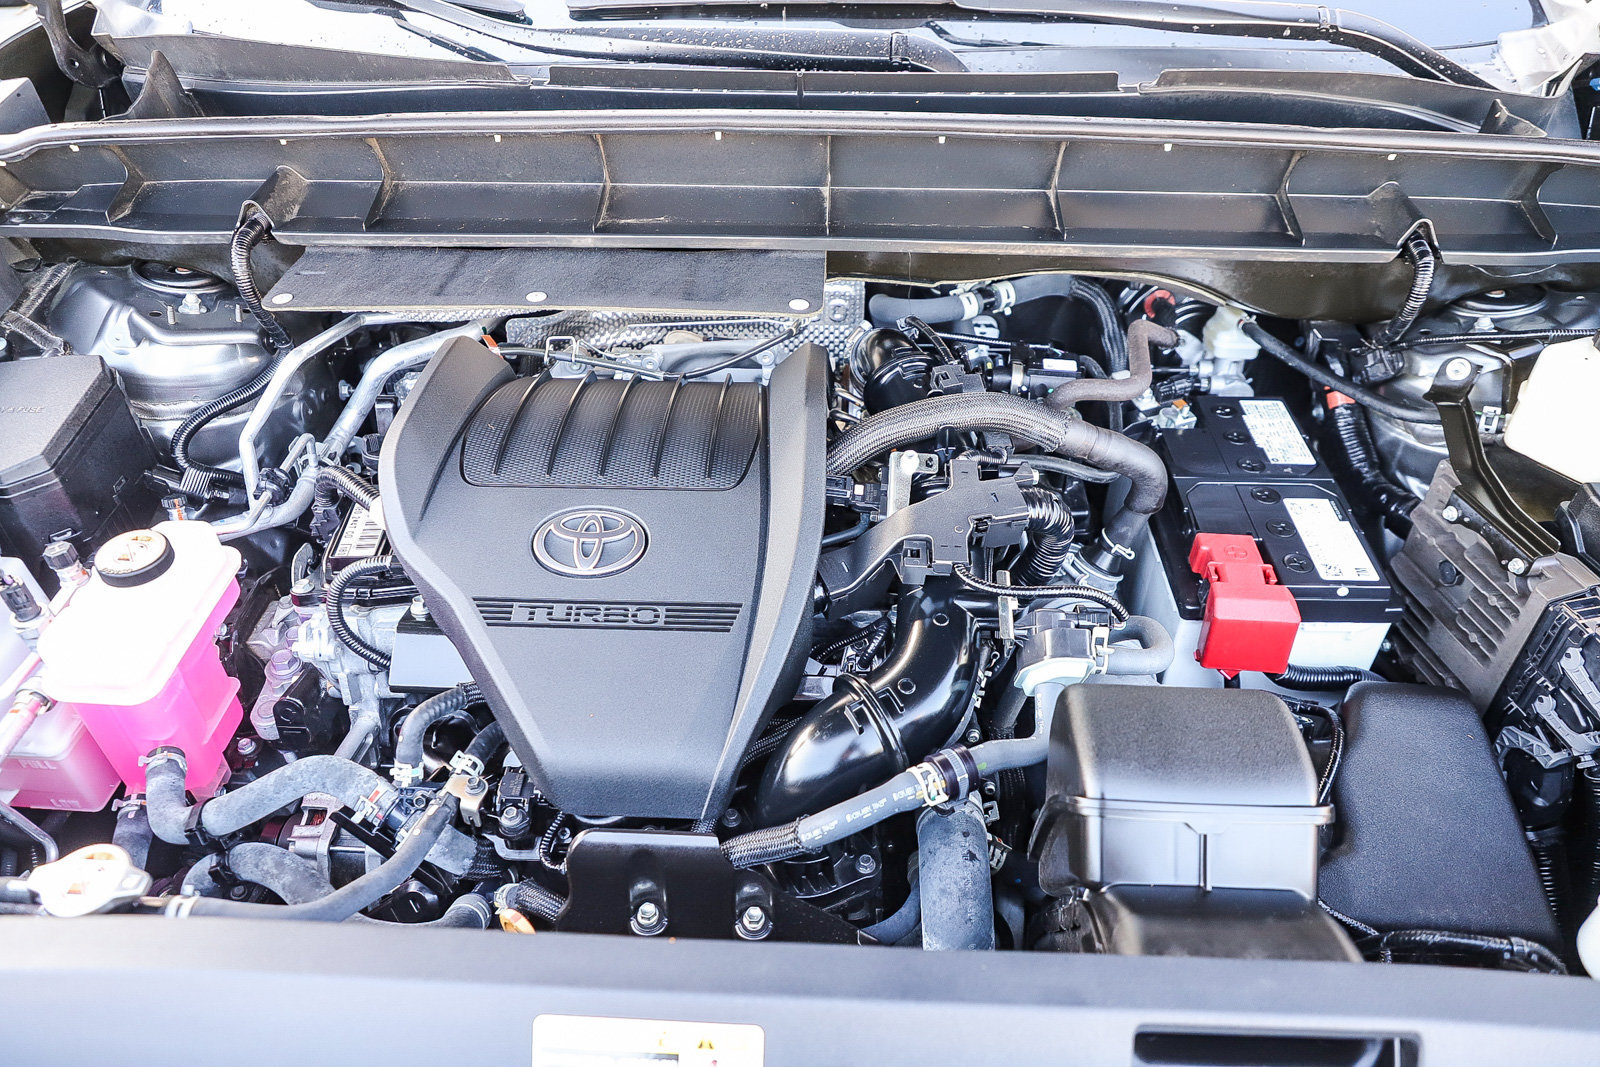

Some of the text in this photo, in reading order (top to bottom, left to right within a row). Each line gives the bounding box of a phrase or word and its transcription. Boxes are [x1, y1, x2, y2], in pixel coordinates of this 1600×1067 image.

[16, 406, 45, 414] FUSE
[514, 602, 662, 625] TURBO
[18, 759, 57, 769] FULL
